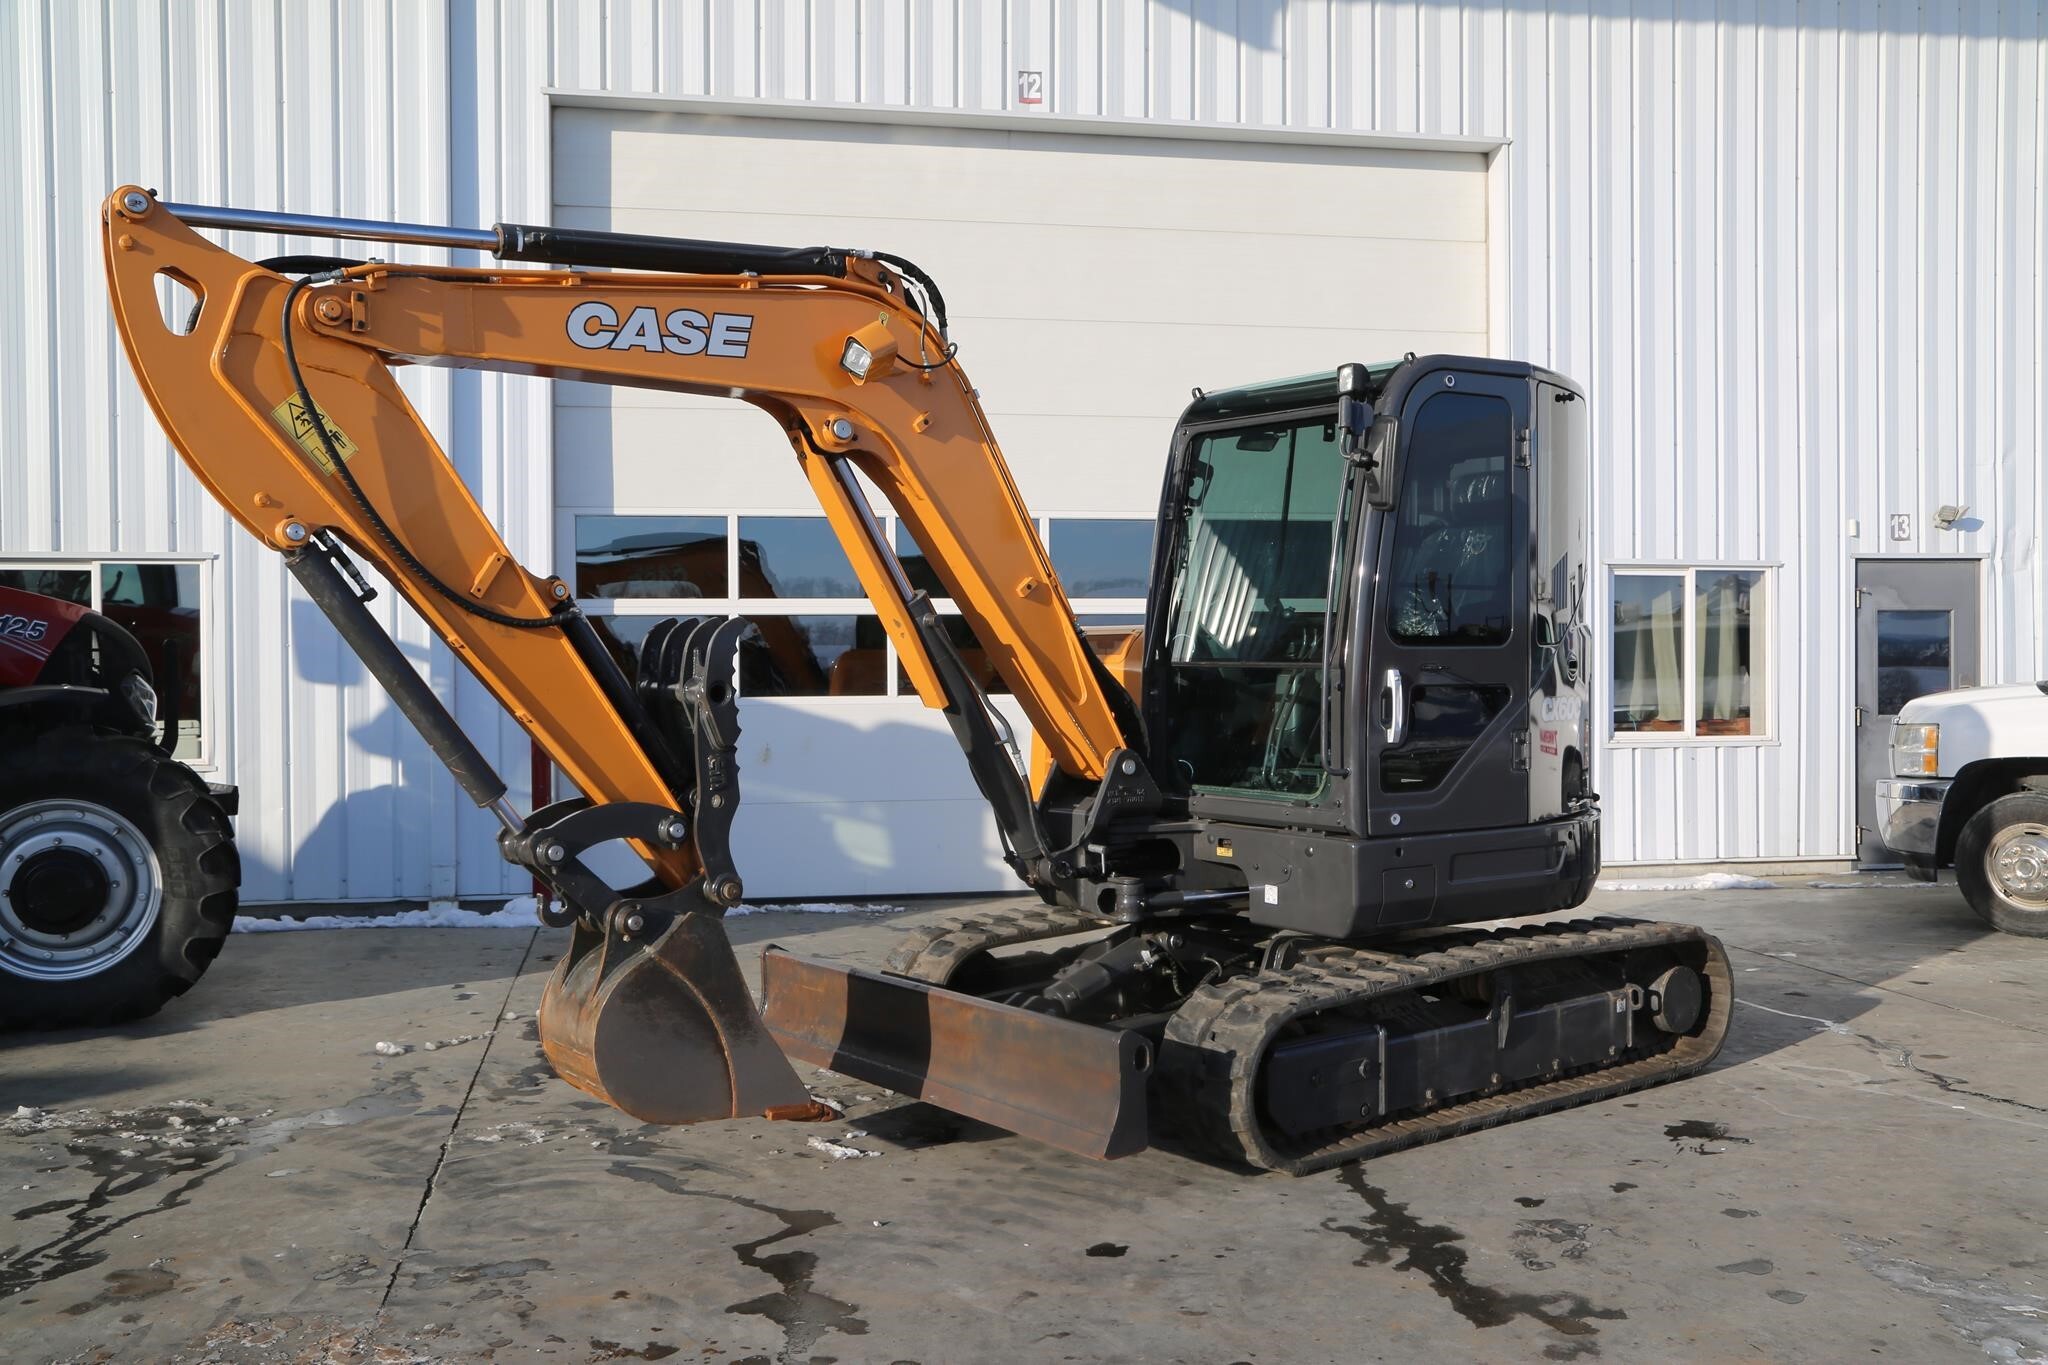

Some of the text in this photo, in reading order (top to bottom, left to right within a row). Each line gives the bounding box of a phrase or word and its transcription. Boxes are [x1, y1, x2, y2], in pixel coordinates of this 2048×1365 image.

[1019, 72, 1041, 99] 12
[566, 301, 754, 359] CASE
[1891, 515, 1910, 538] 13
[0, 614, 48, 641] 125
